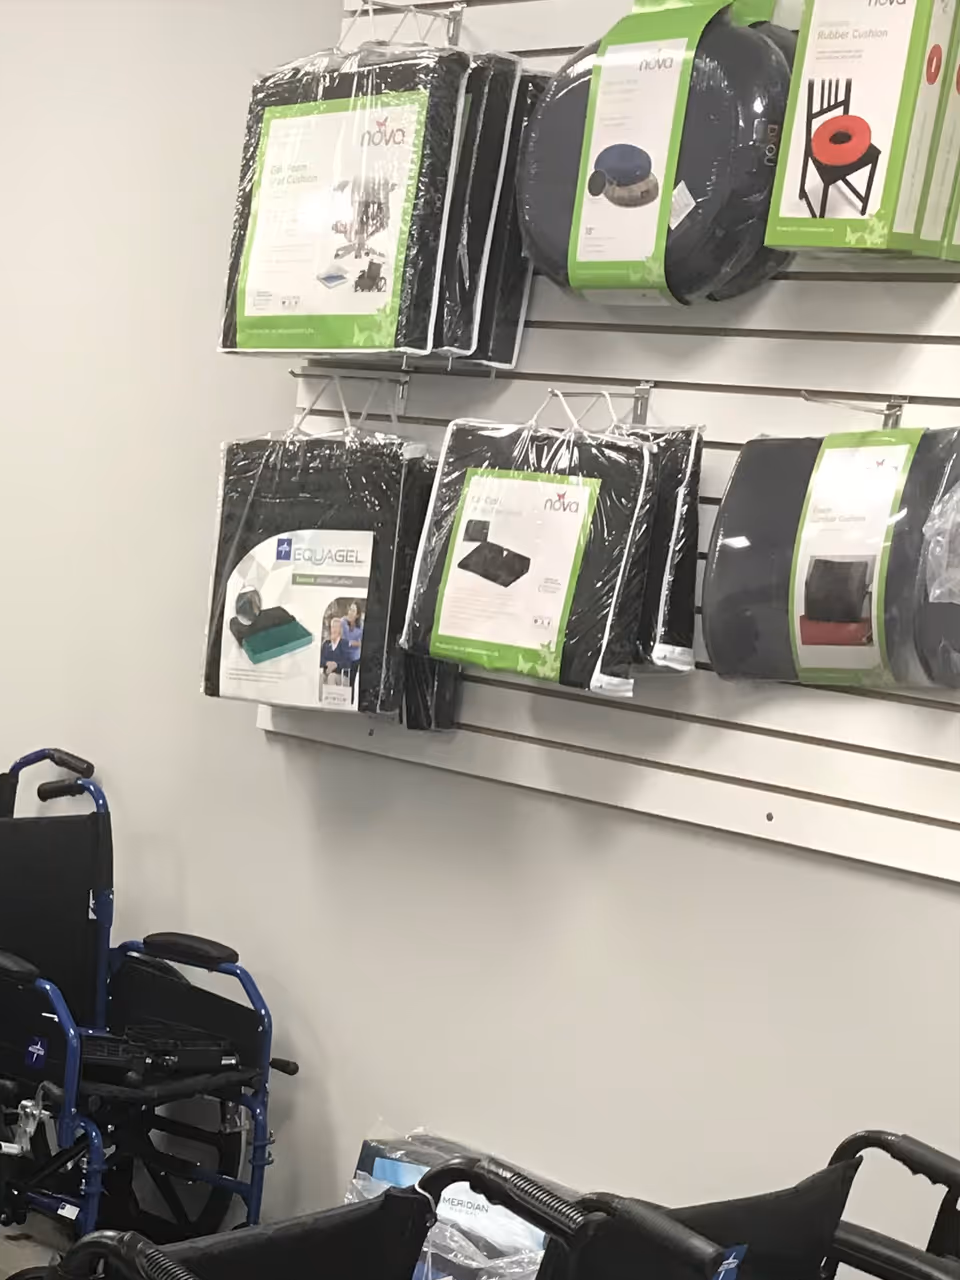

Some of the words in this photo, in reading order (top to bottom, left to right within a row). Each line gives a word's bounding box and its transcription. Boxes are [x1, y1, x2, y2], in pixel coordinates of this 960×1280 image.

[817, 29, 849, 40] Rubber
[852, 28, 888, 39] Cushion
[640, 56, 673, 72] nova
[360, 127, 406, 147] nova
[544, 496, 579, 513] nova
[293, 547, 365, 566] EQUAGEL
[442, 1196, 490, 1213] MERIDIAN
